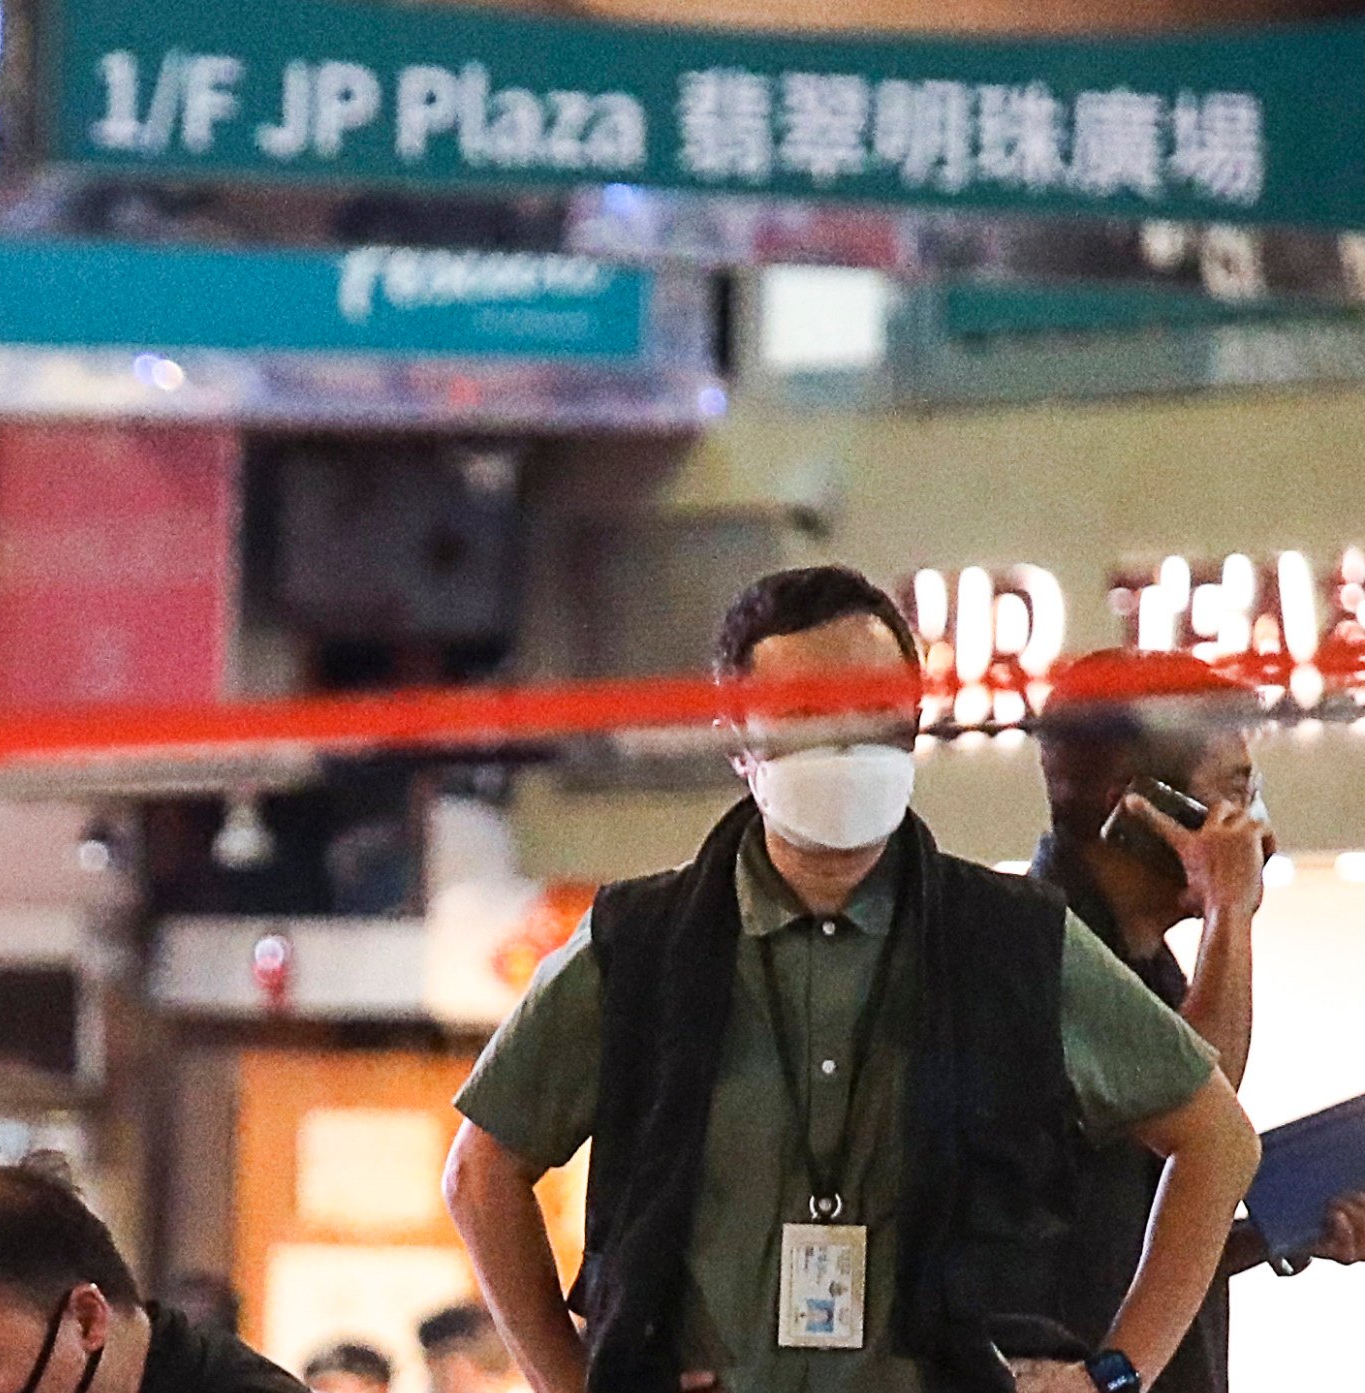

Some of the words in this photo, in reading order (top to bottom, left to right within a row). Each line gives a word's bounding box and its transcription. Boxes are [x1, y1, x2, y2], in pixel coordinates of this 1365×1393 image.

[88, 48, 242, 153] 1/F
[256, 57, 382, 161] JP
[394, 60, 648, 171] Plaza
[677, 67, 1264, 205] 翡翠明珠廣場
